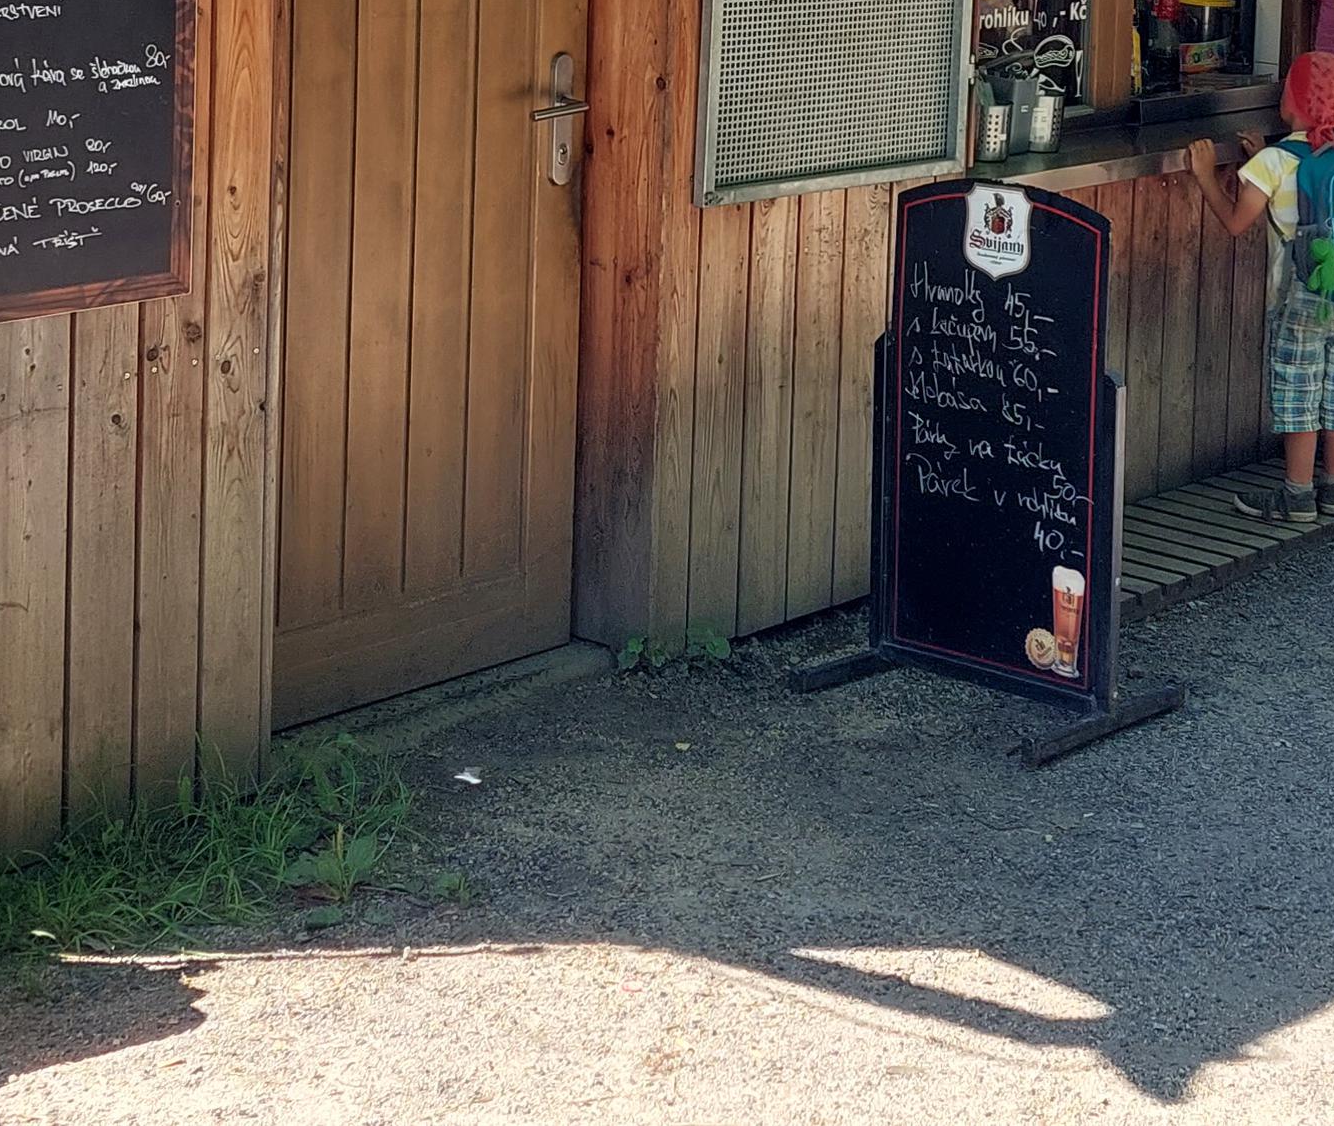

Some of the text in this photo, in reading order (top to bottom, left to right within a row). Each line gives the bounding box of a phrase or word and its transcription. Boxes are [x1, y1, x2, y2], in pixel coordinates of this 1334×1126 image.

[980, 5, 1029, 29] rohlíku
[71, 68, 85, 80] se
[98, 81, 108, 93] a
[22, 145, 69, 164] VIRGIN
[49, 197, 142, 216] PROSECCO
[969, 228, 1024, 255] Svijany
[969, 439, 994, 459] na
[905, 453, 979, 501] Párek
[995, 490, 1006, 506] v
